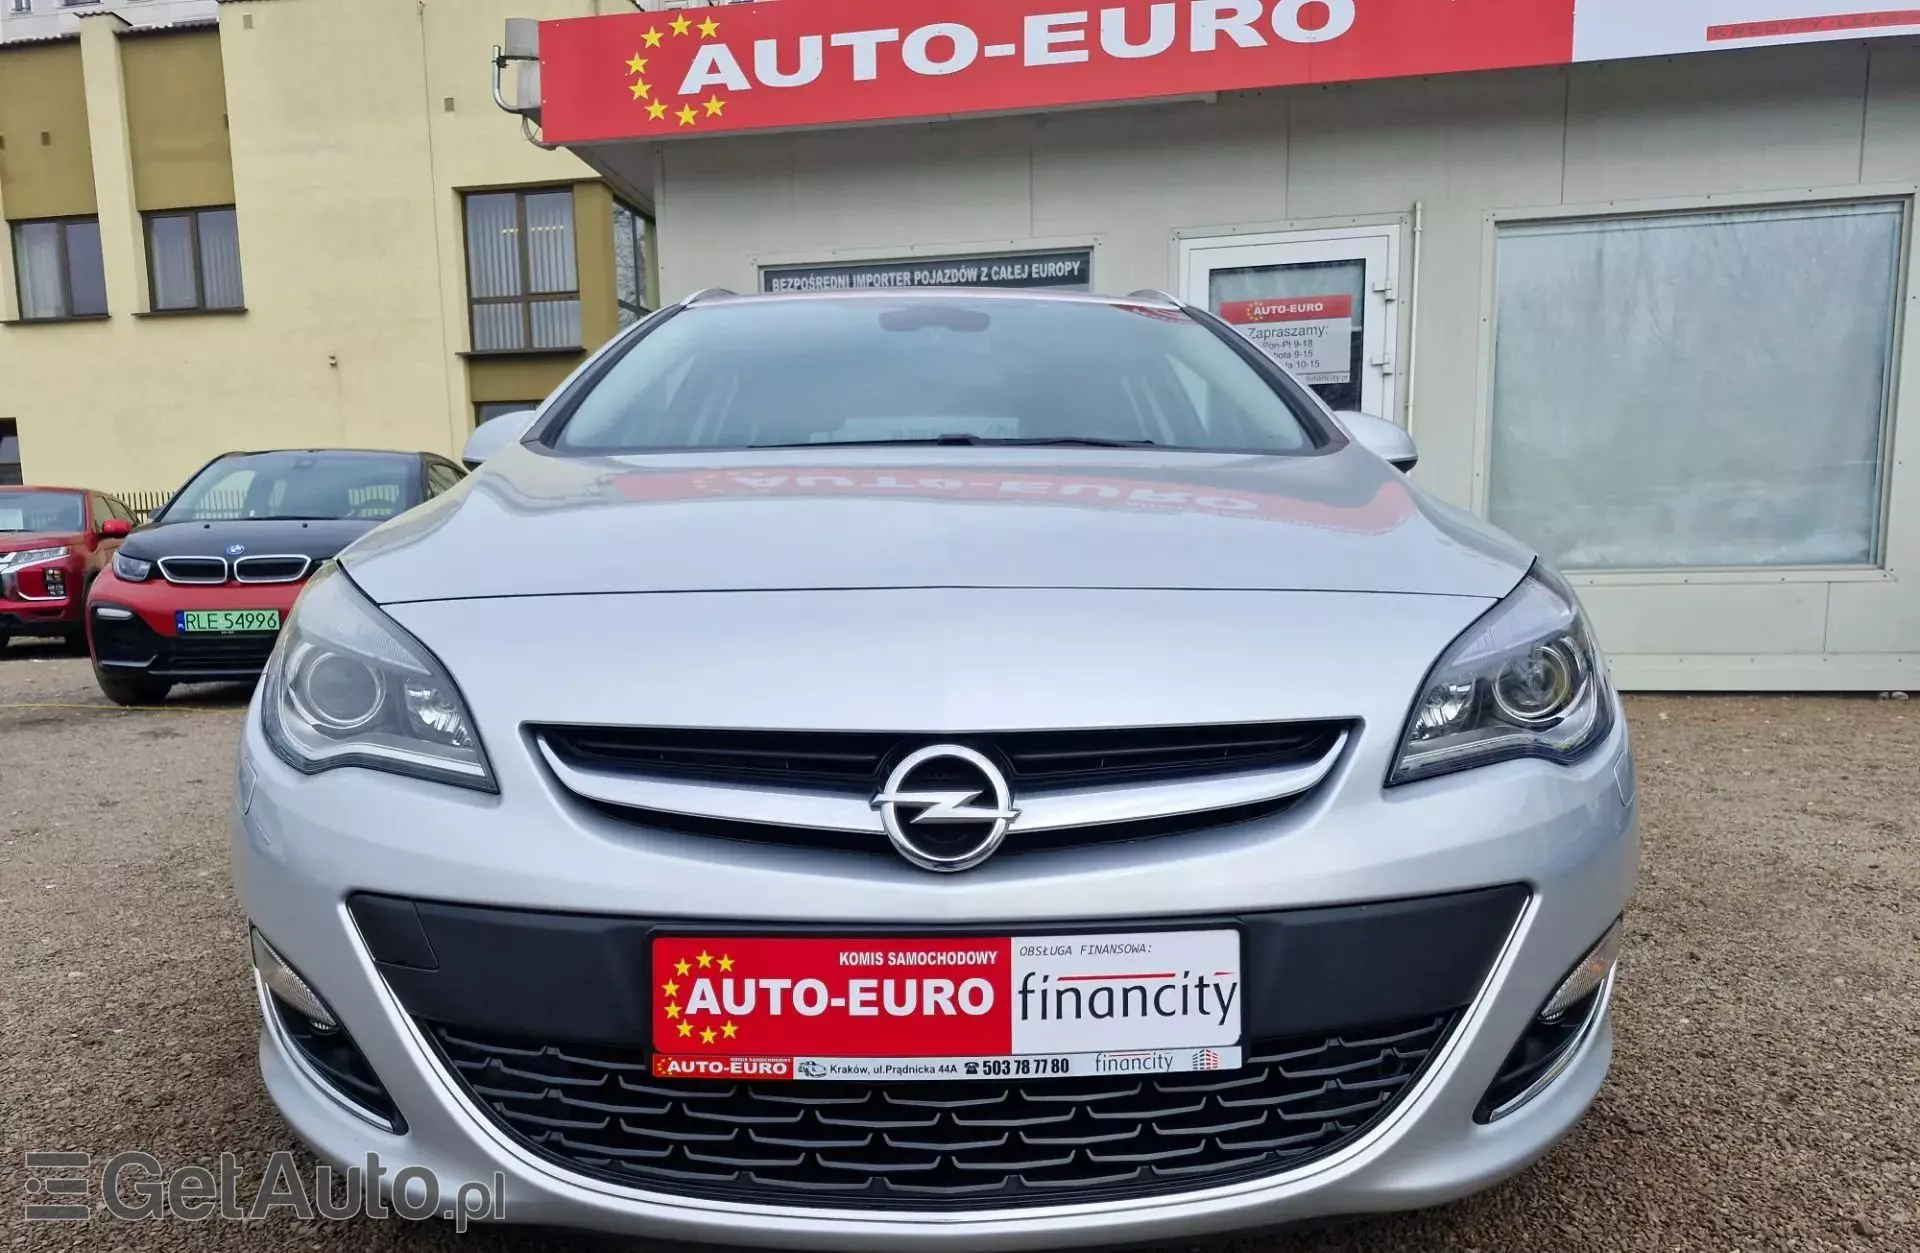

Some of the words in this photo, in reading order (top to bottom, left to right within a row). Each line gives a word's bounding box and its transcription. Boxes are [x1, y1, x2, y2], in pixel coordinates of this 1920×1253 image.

[677, 0, 1356, 95] AUTO-EURO
[772, 273, 849, 292] BEZPOŚREDNI
[853, 271, 911, 289] IMPORTER
[914, 265, 978, 285] POJAZDÓW
[980, 267, 989, 282] Z
[991, 264, 1028, 281] CAŁEJ
[1032, 261, 1080, 278] EUROPY
[1254, 303, 1323, 315] AUTO-EURO
[1248, 326, 1329, 340] Zapraszamy:
[1294, 339, 1313, 348] 9-18
[1294, 350, 1313, 358] 9-15
[1297, 360, 1320, 368] 10-15
[186, 613, 219, 629] RLE
[224, 613, 277, 629] 54996
[839, 951, 884, 966] KOMIS
[888, 950, 998, 966] SAMOCHODOWY
[1019, 945, 1072, 957] OBSŁUGA
[1080, 943, 1152, 956] FINANSOWA:
[685, 977, 994, 1017] AUTO-EURO
[1018, 970, 1238, 1025] financity
[667, 1060, 787, 1074] AUTO-EURO
[830, 1061, 870, 1075] Kraków,
[873, 1060, 935, 1075] ul.Prądnicka
[938, 1061, 957, 1073] 44A
[983, 1060, 1010, 1075] 503
[1014, 1060, 1030, 1075] 78
[1033, 1059, 1048, 1074] 77
[1051, 1058, 1069, 1074] 80
[1095, 1052, 1174, 1072] financity
